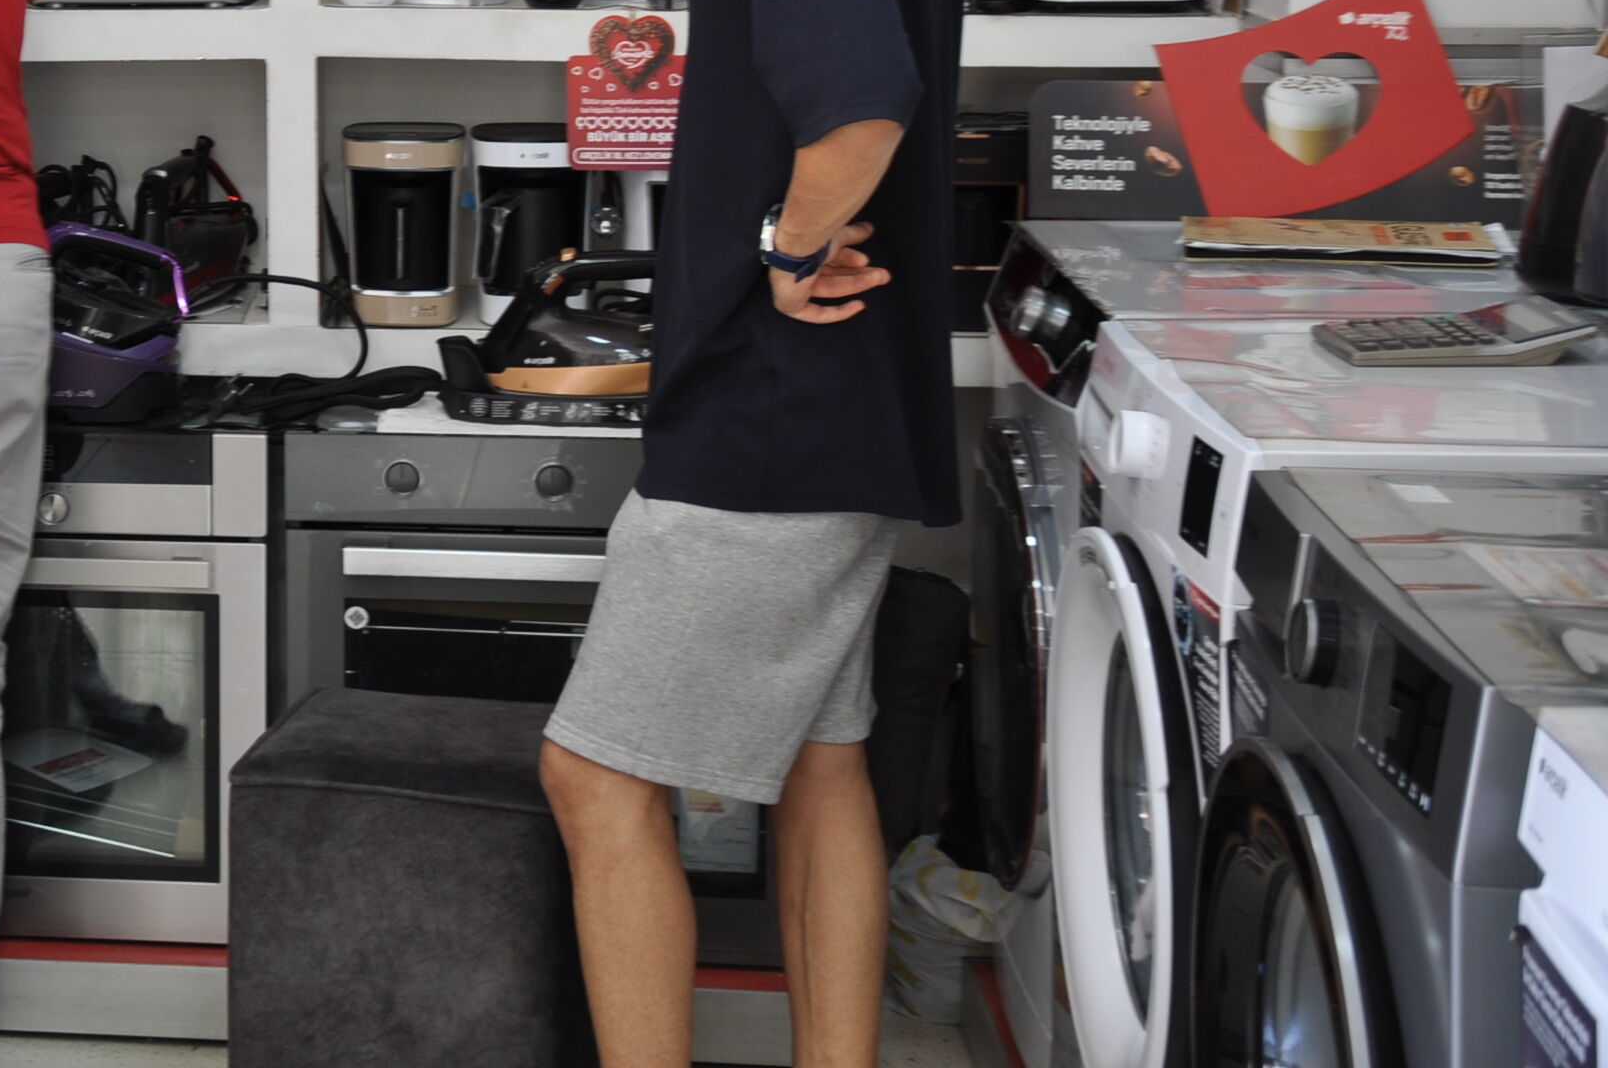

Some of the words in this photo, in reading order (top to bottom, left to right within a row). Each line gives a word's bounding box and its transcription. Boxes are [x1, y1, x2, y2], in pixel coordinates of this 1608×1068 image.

[1354, 11, 1414, 28] arçelik
[1051, 114, 1152, 135] Teknolojiyle
[1051, 134, 1106, 151] Kahve
[1051, 154, 1137, 172] Severlerin
[1051, 174, 1126, 191] Kalbinde
